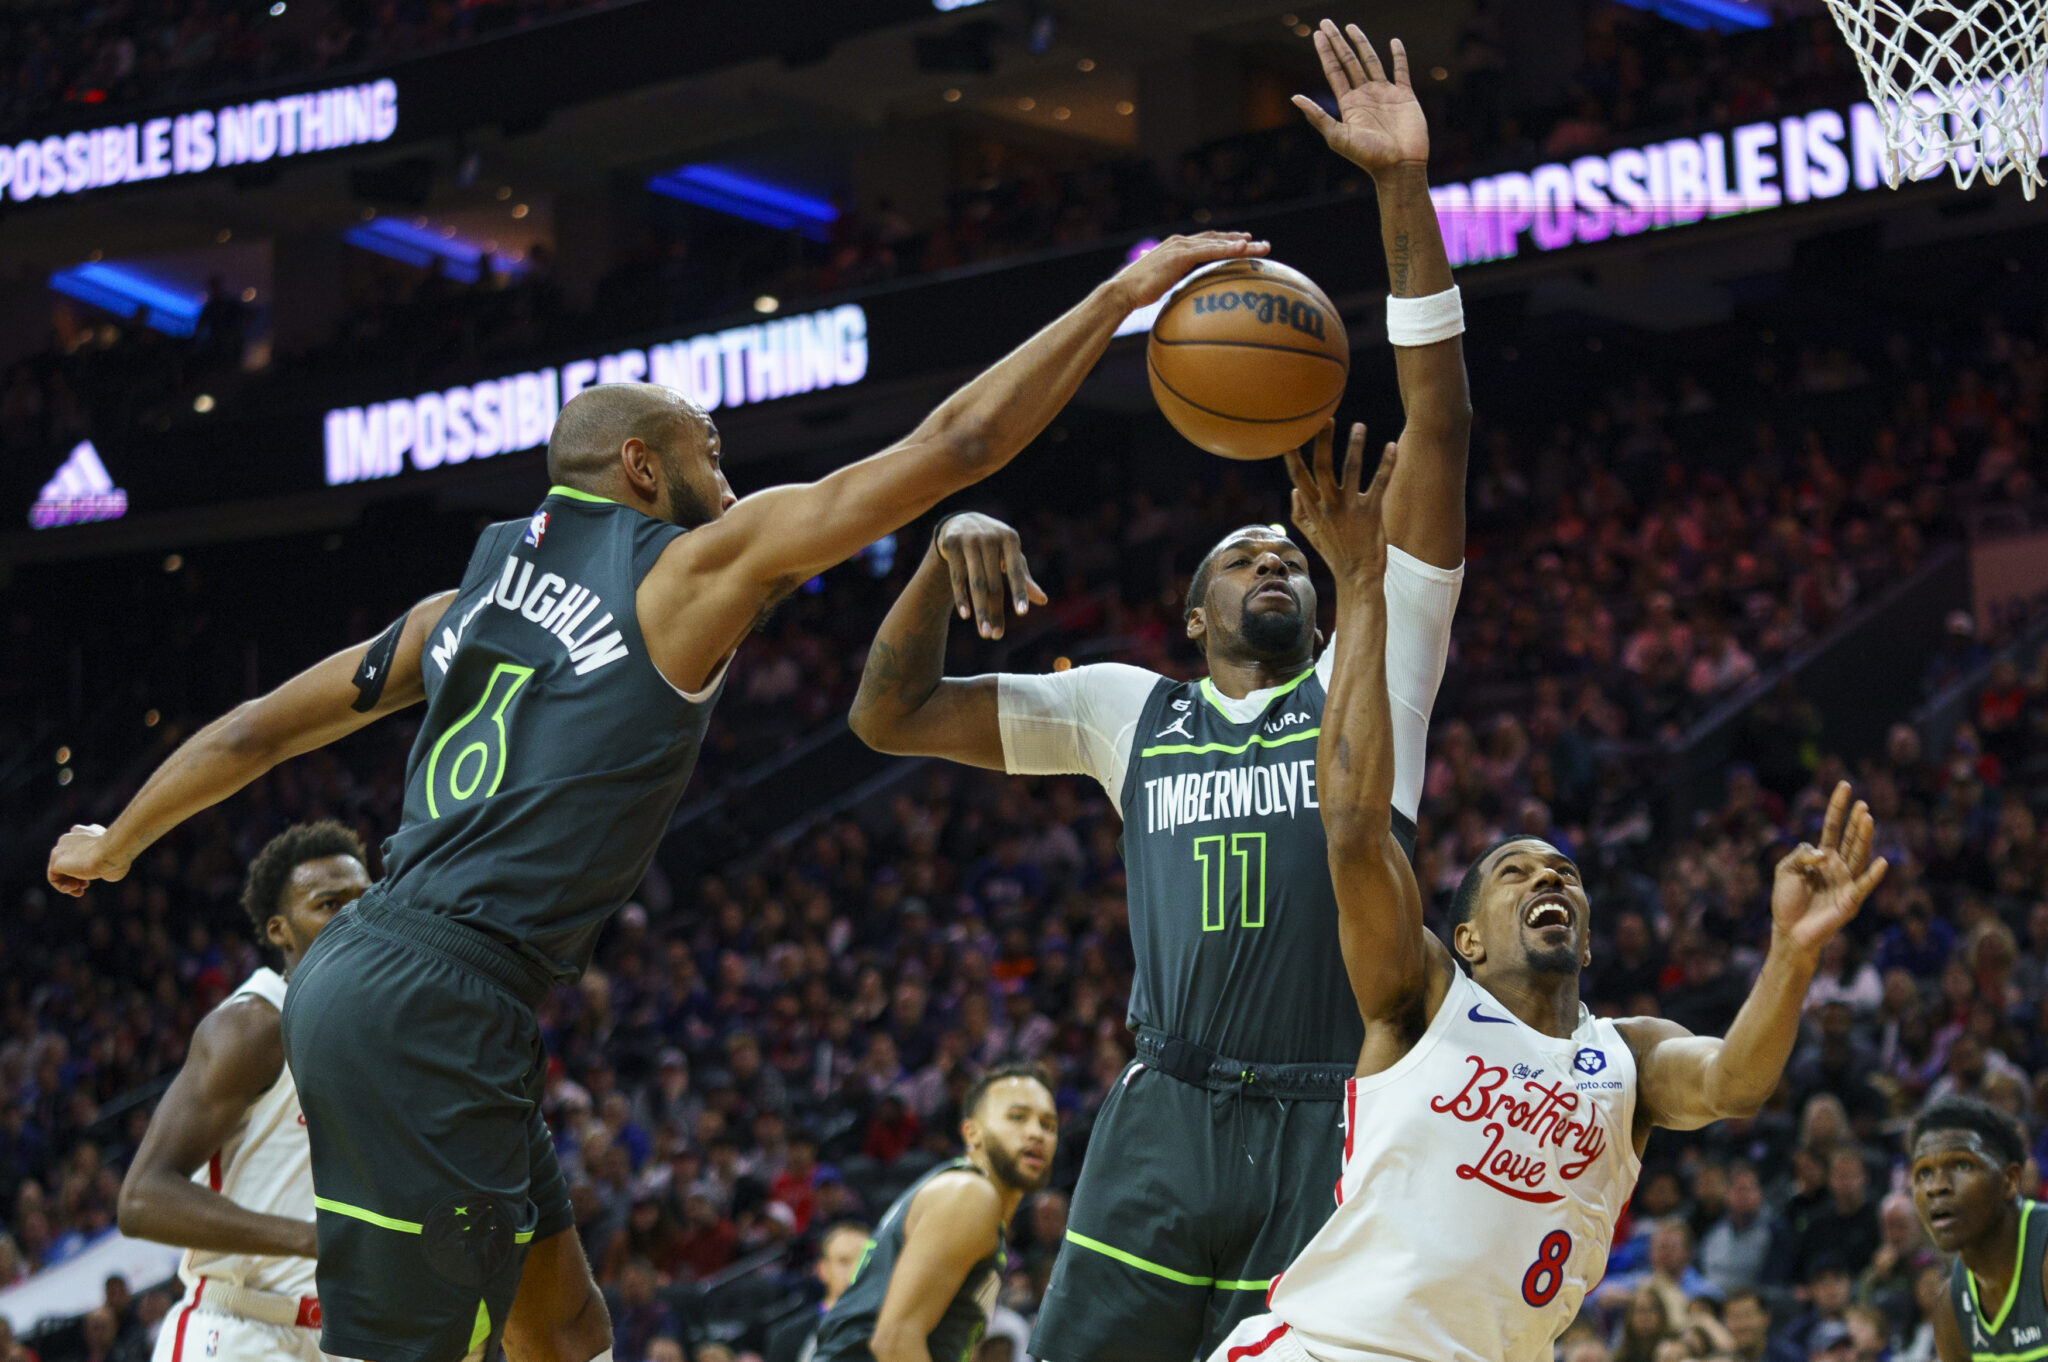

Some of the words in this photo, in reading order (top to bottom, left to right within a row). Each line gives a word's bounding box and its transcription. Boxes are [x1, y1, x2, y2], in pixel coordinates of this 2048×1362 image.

[172, 110, 216, 175] IS
[217, 77, 398, 168] NOTHING
[1780, 108, 1849, 203] IS
[649, 302, 868, 412] NOTHING
[1192, 291, 1326, 343] Wilson
[430, 554, 629, 676] MUGHLIN
[426, 662, 535, 819] 6
[1193, 832, 1266, 931] 11
[1430, 1055, 1606, 1180] Brotherly
[1456, 1122, 1566, 1204] Love
[1521, 1229, 1572, 1308] 8
